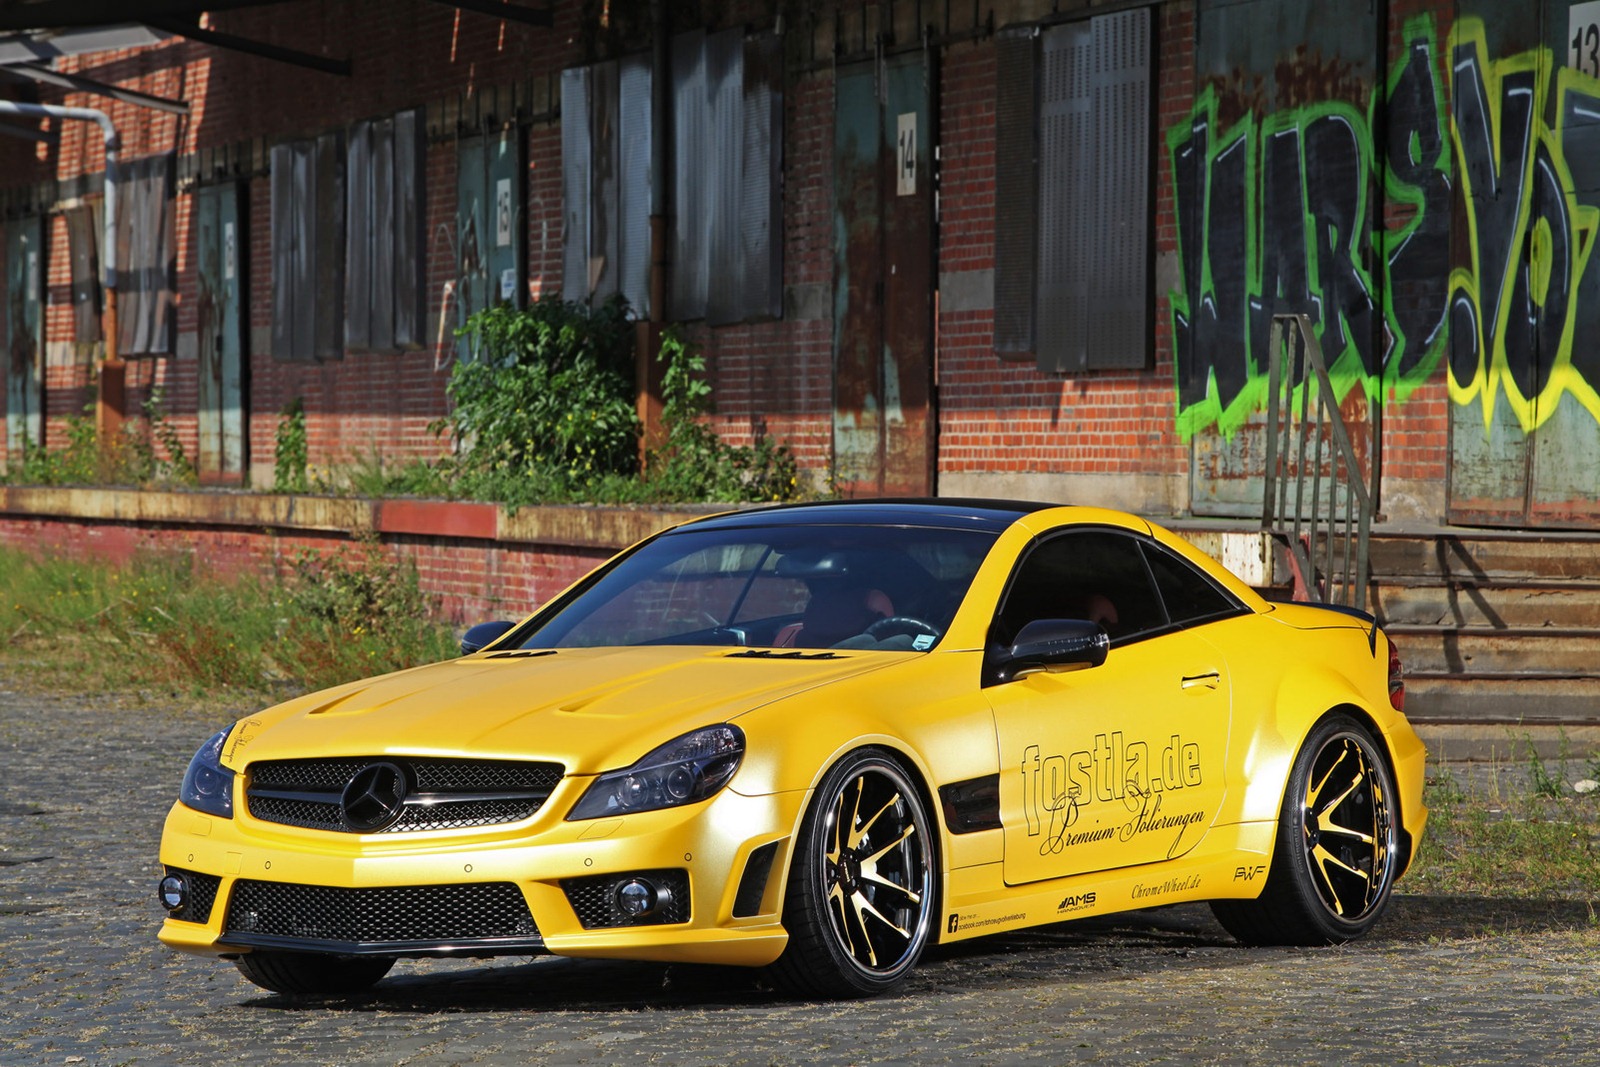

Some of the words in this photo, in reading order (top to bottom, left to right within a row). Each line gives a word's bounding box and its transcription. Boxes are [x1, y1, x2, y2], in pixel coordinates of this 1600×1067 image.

[1572, 23, 1600, 79] 13
[900, 129, 915, 179] 14
[498, 191, 509, 232] 15
[1021, 731, 1202, 837] fostla.de
[1065, 892, 1096, 908] AMS
[1131, 874, 1201, 899] ChromeWheel.de
